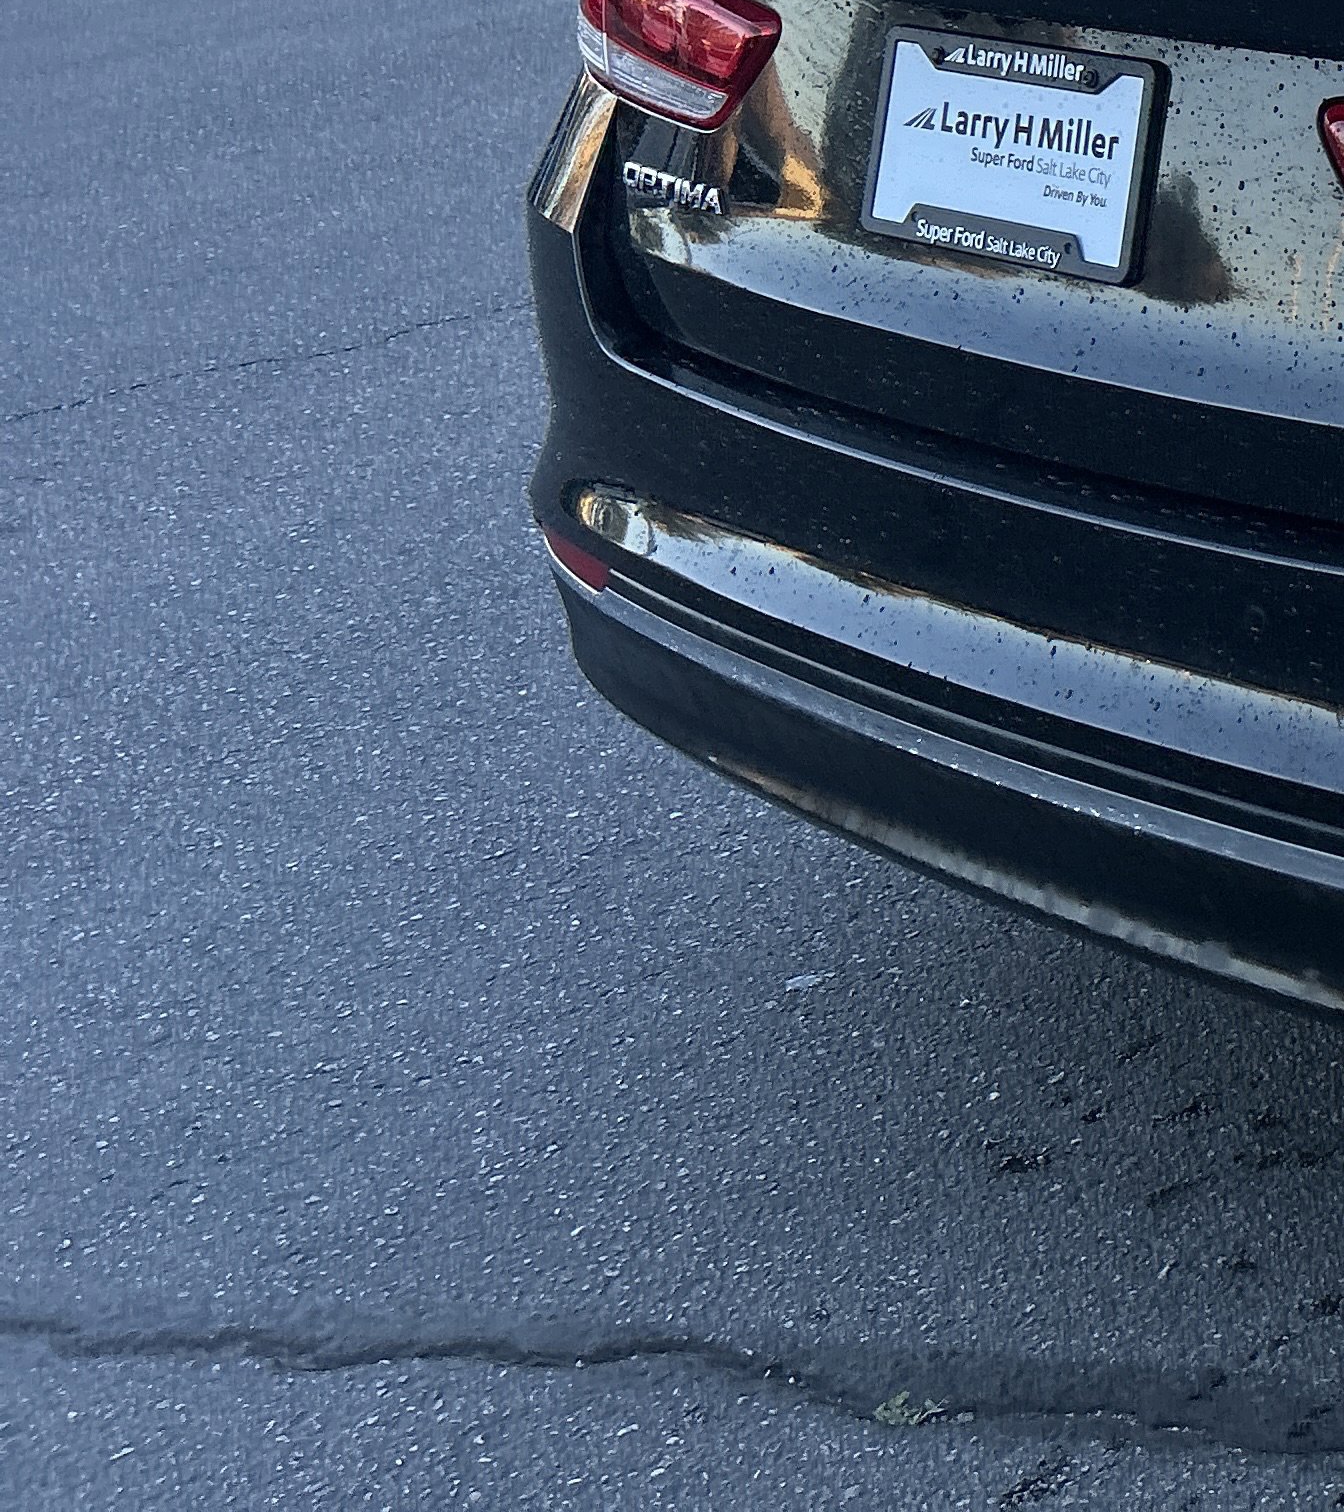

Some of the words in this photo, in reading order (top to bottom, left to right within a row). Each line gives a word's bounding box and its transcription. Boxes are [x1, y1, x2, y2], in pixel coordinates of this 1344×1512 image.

[966, 44, 1012, 76] Larry
[1014, 52, 1028, 72] H
[1029, 53, 1085, 83] Miller
[940, 101, 1010, 149] Larry
[1013, 113, 1034, 146] H
[1037, 116, 1120, 160] Miller
[622, 160, 723, 216] OPTIMA
[970, 147, 1006, 169] Super
[1007, 152, 1035, 173] Ford
[1035, 157, 1058, 177] Salt
[1059, 161, 1087, 182] Lake
[1088, 166, 1113, 188] City
[1043, 185, 1074, 203] Driven
[1075, 190, 1089, 208] By
[1089, 192, 1107, 208] You
[915, 218, 954, 245] Super
[953, 226, 985, 251] Ford
[985, 235, 1009, 256] Salt
[1008, 242, 1036, 261] Lake
[1036, 245, 1062, 268] City
